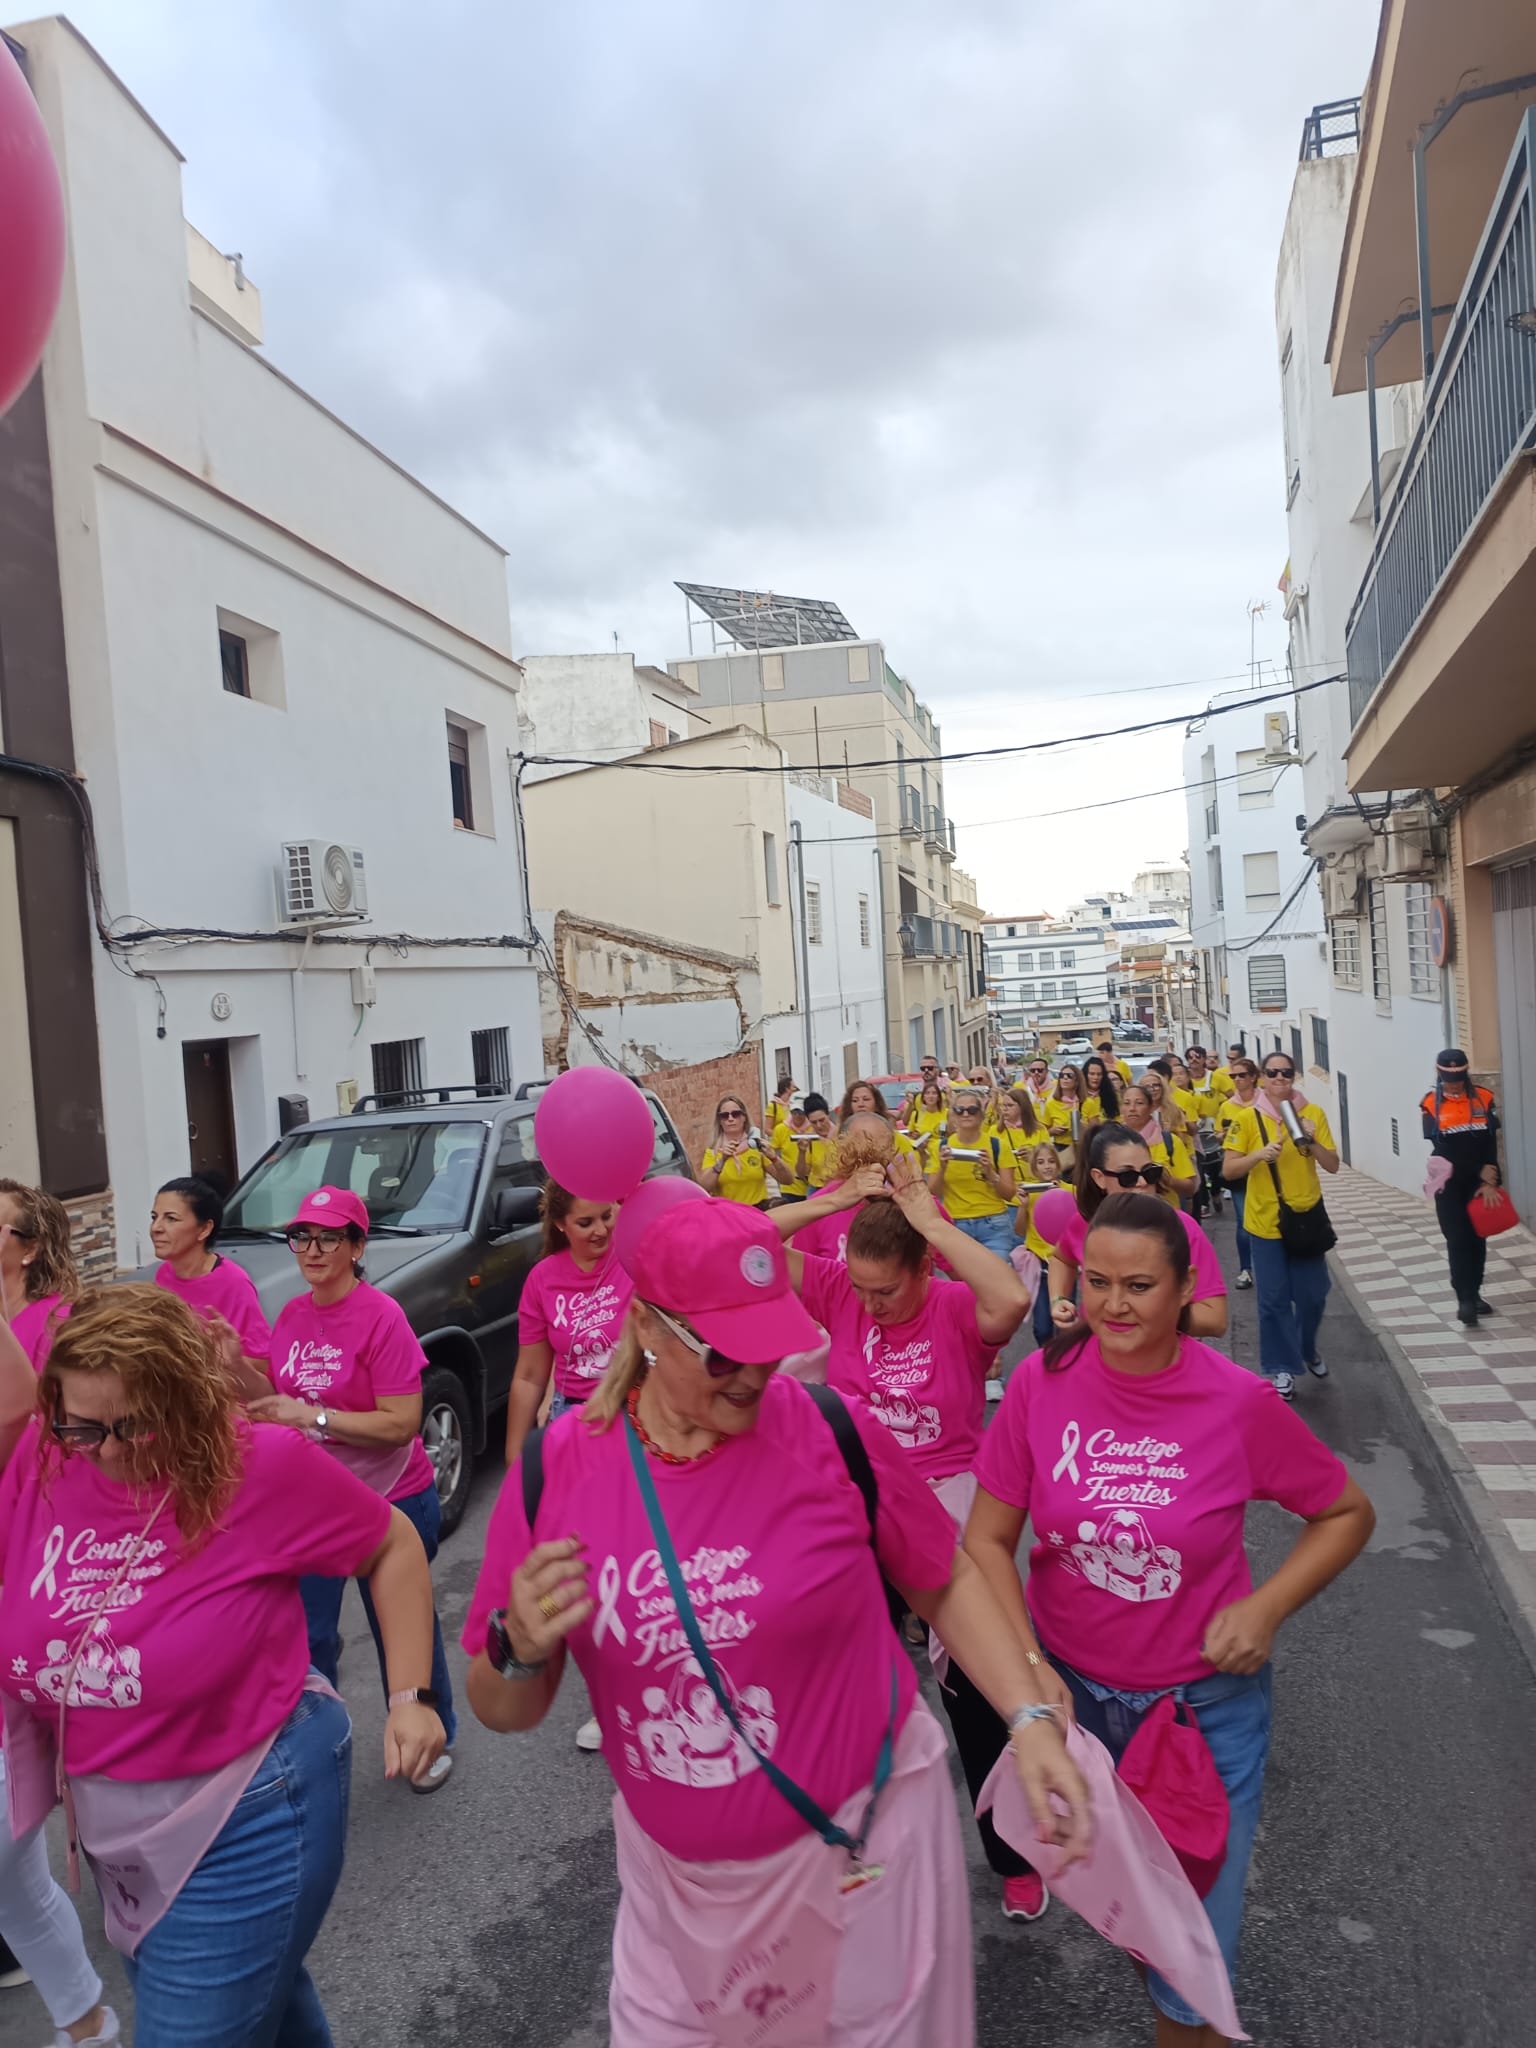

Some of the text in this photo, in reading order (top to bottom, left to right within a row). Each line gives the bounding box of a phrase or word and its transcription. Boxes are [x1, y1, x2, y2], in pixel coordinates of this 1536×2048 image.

[300, 1341, 343, 1361] Contigo
[324, 1360, 342, 1371] más
[880, 1352, 932, 1371] omos má
[293, 1370, 334, 1387] Fuertes
[1085, 1428, 1183, 1464] Contigo
[1089, 1460, 1189, 1480] somos más
[1077, 1475, 1178, 1505] Fuertes
[711, 1572, 764, 1603] más
